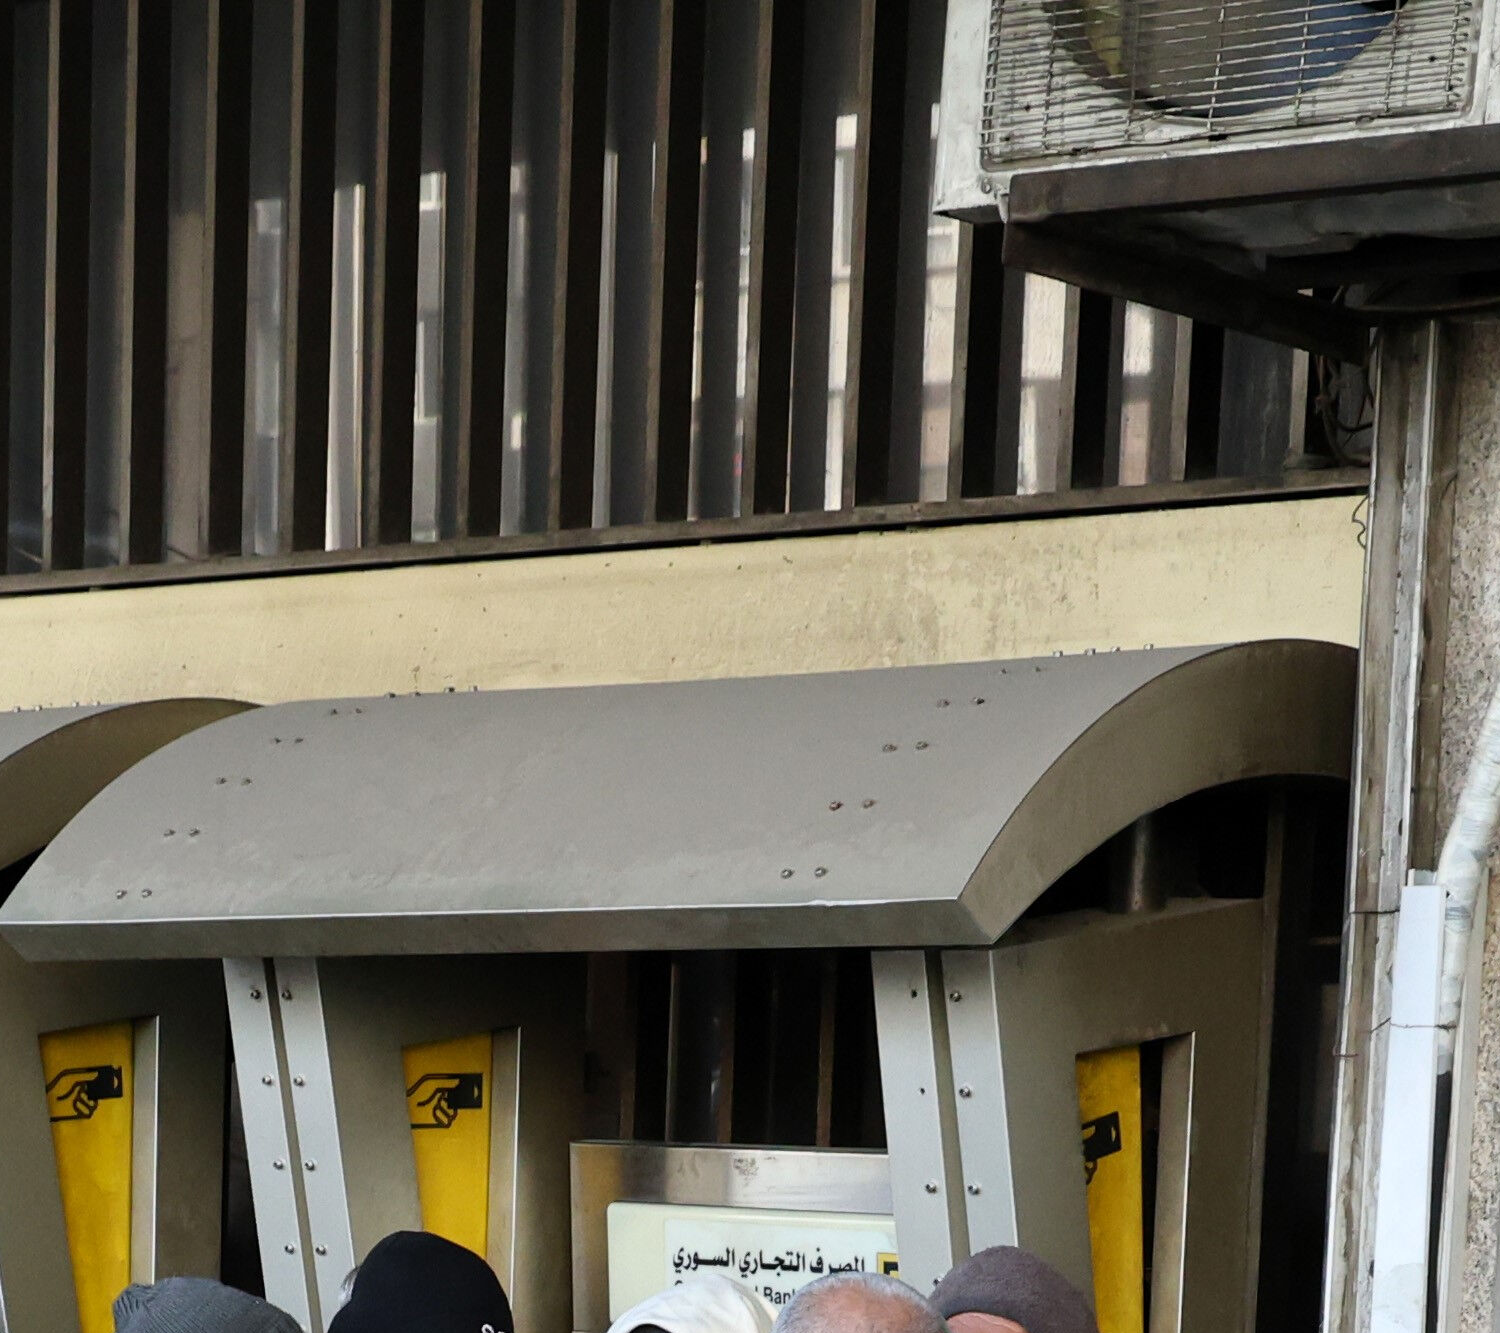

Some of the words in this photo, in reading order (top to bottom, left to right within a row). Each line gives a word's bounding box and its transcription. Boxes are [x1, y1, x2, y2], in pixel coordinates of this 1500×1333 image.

[672, 1246, 736, 1275] السوري
[738, 1249, 806, 1279] التجاري
[808, 1246, 866, 1274] المصرف
